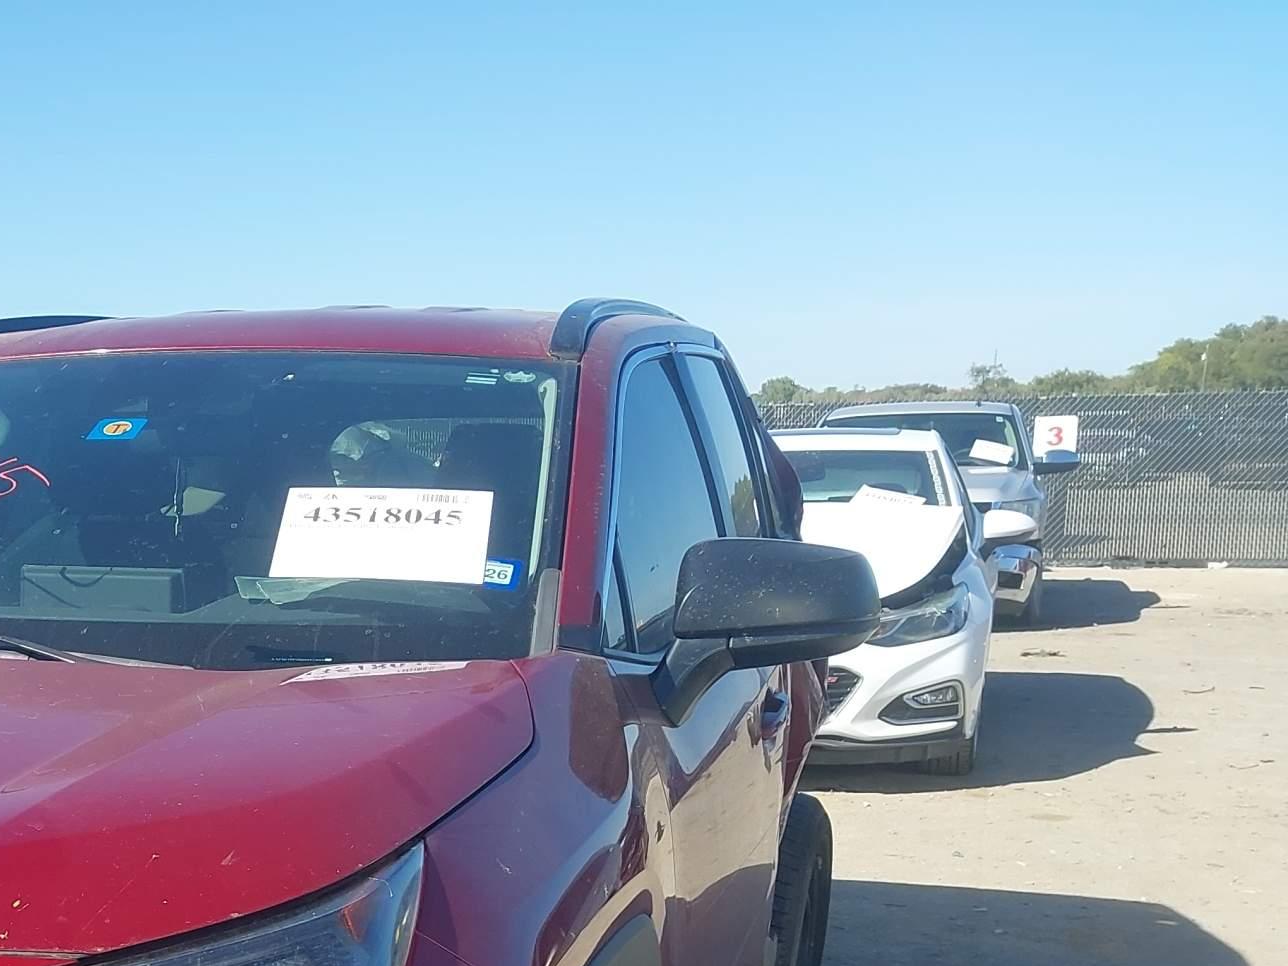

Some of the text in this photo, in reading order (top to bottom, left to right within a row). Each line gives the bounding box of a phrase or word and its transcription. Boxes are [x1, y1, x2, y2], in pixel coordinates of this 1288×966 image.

[1046, 426, 1063, 446] 3
[303, 506, 463, 527] 43518045
[485, 567, 509, 580] 26
